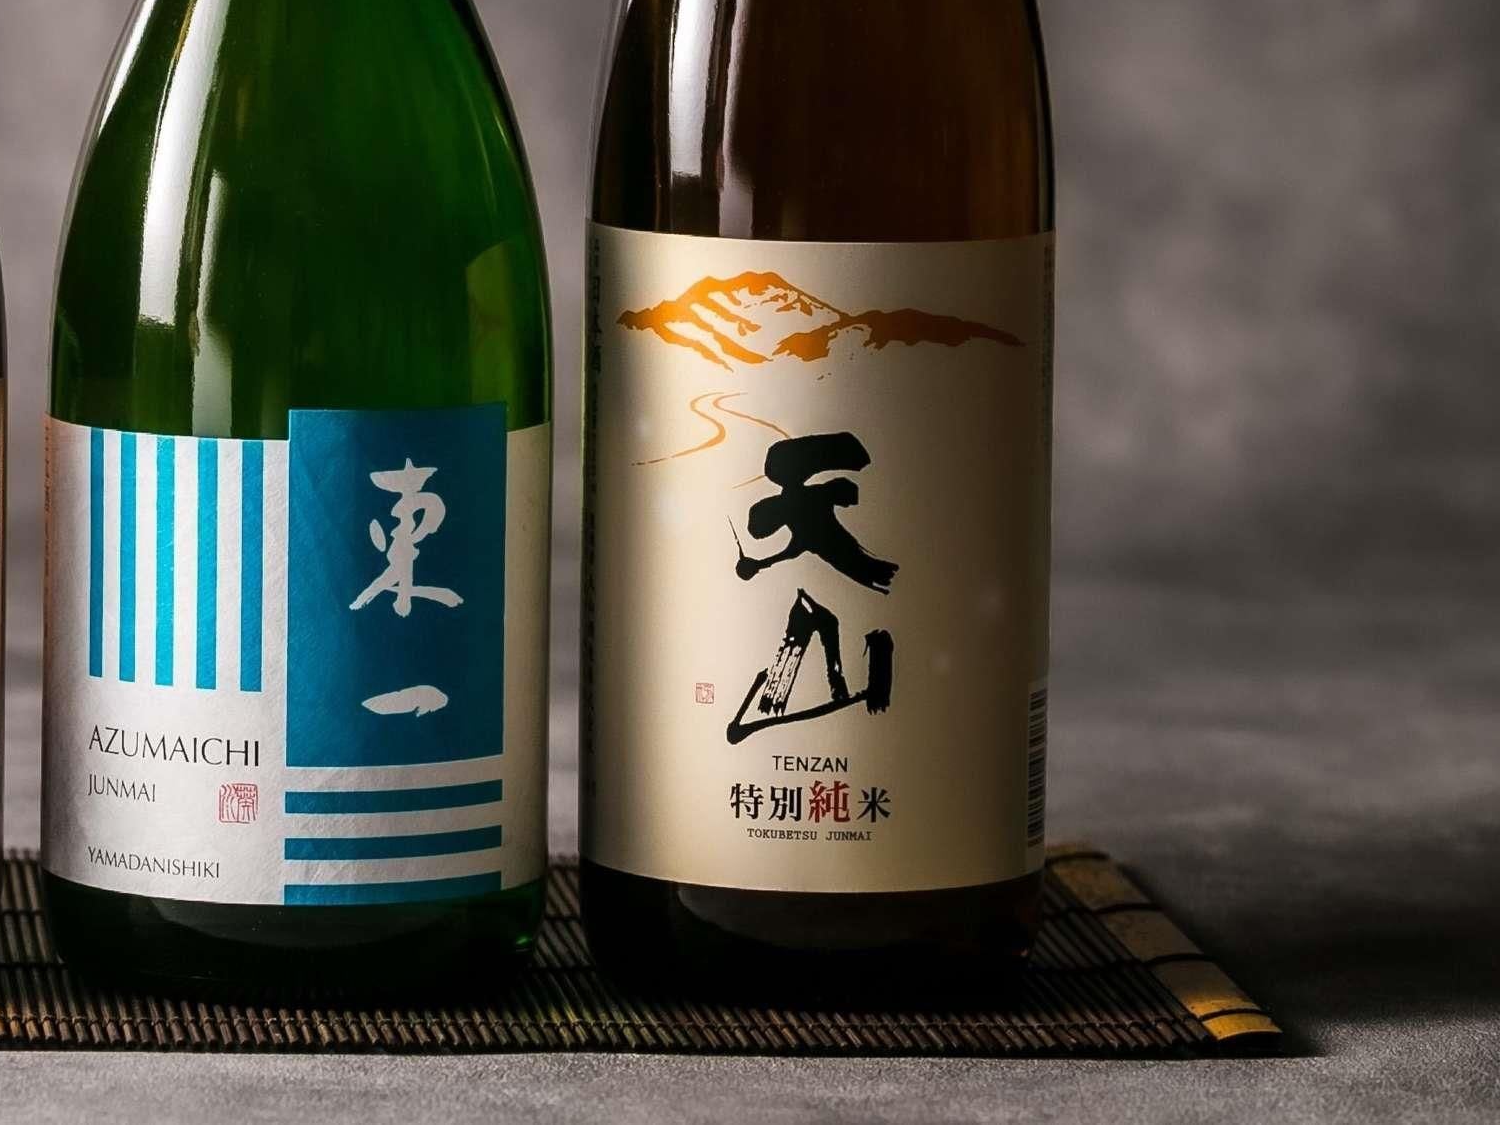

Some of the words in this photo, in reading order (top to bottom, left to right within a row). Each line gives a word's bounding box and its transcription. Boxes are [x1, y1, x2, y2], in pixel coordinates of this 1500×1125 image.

[349, 458, 464, 717] 東一
[726, 431, 900, 745] 天山
[88, 724, 260, 768] AZUMAICHI
[772, 755, 848, 772] TENZAN
[88, 773, 156, 803] JUNMAI
[729, 780, 892, 824] 特別純米
[747, 828, 818, 841] TOKUBETSU
[826, 830, 872, 842] JUNMAI
[88, 846, 220, 878] YAMADANISHIKI
